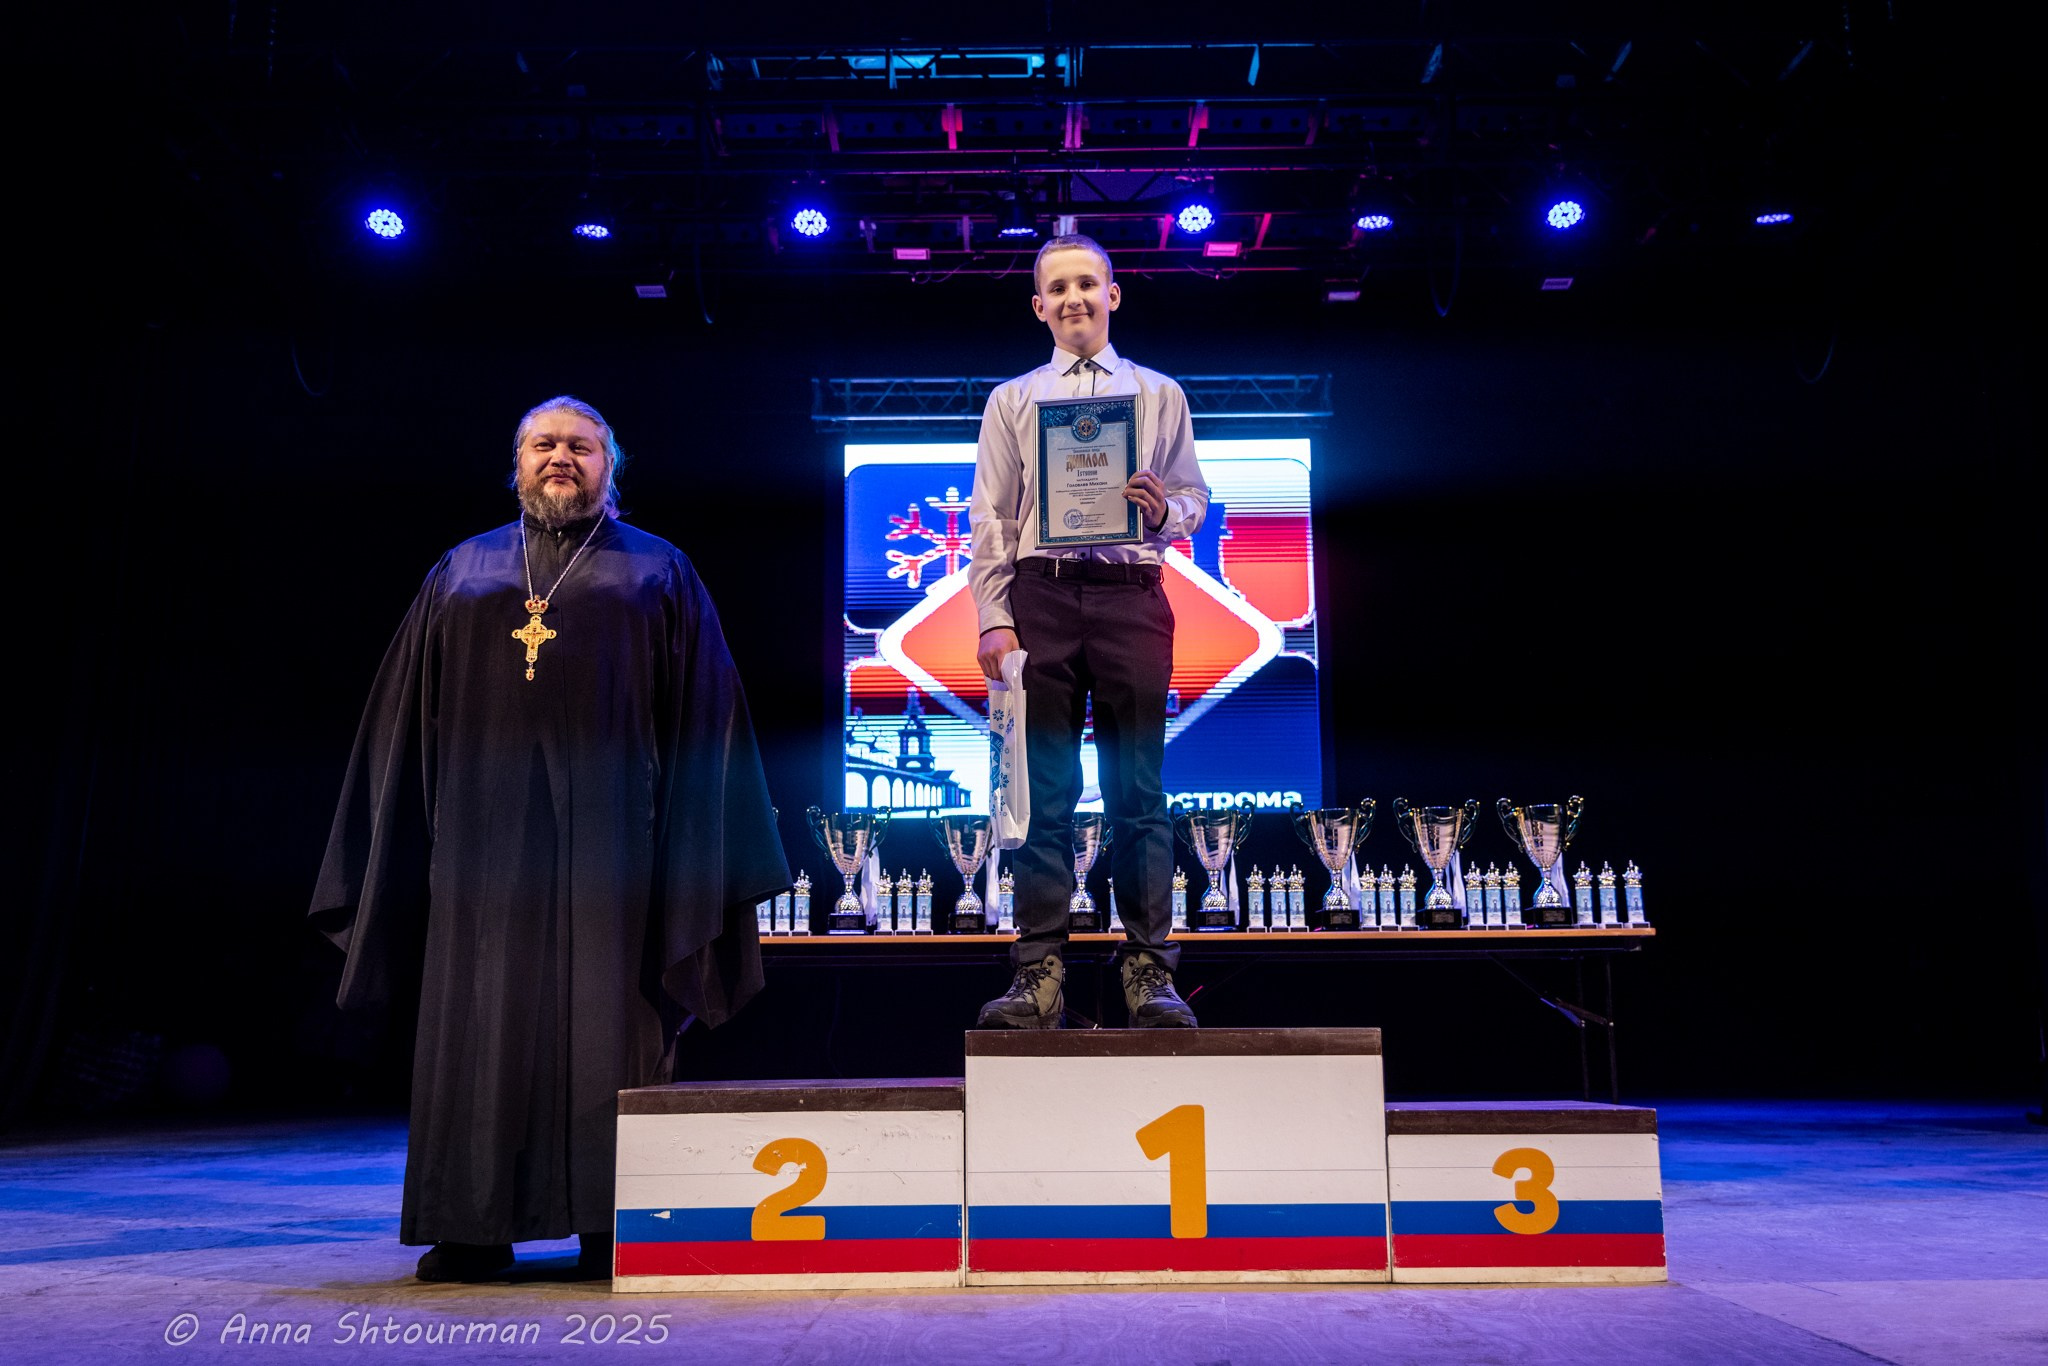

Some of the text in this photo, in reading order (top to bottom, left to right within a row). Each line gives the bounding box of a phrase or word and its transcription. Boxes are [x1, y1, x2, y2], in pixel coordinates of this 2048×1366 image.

[1066, 452, 1108, 472] ДИПЛОМ
[751, 1138, 828, 1241] 2
[1136, 1105, 1207, 1239] 1
[1493, 1148, 1559, 1235] 3
